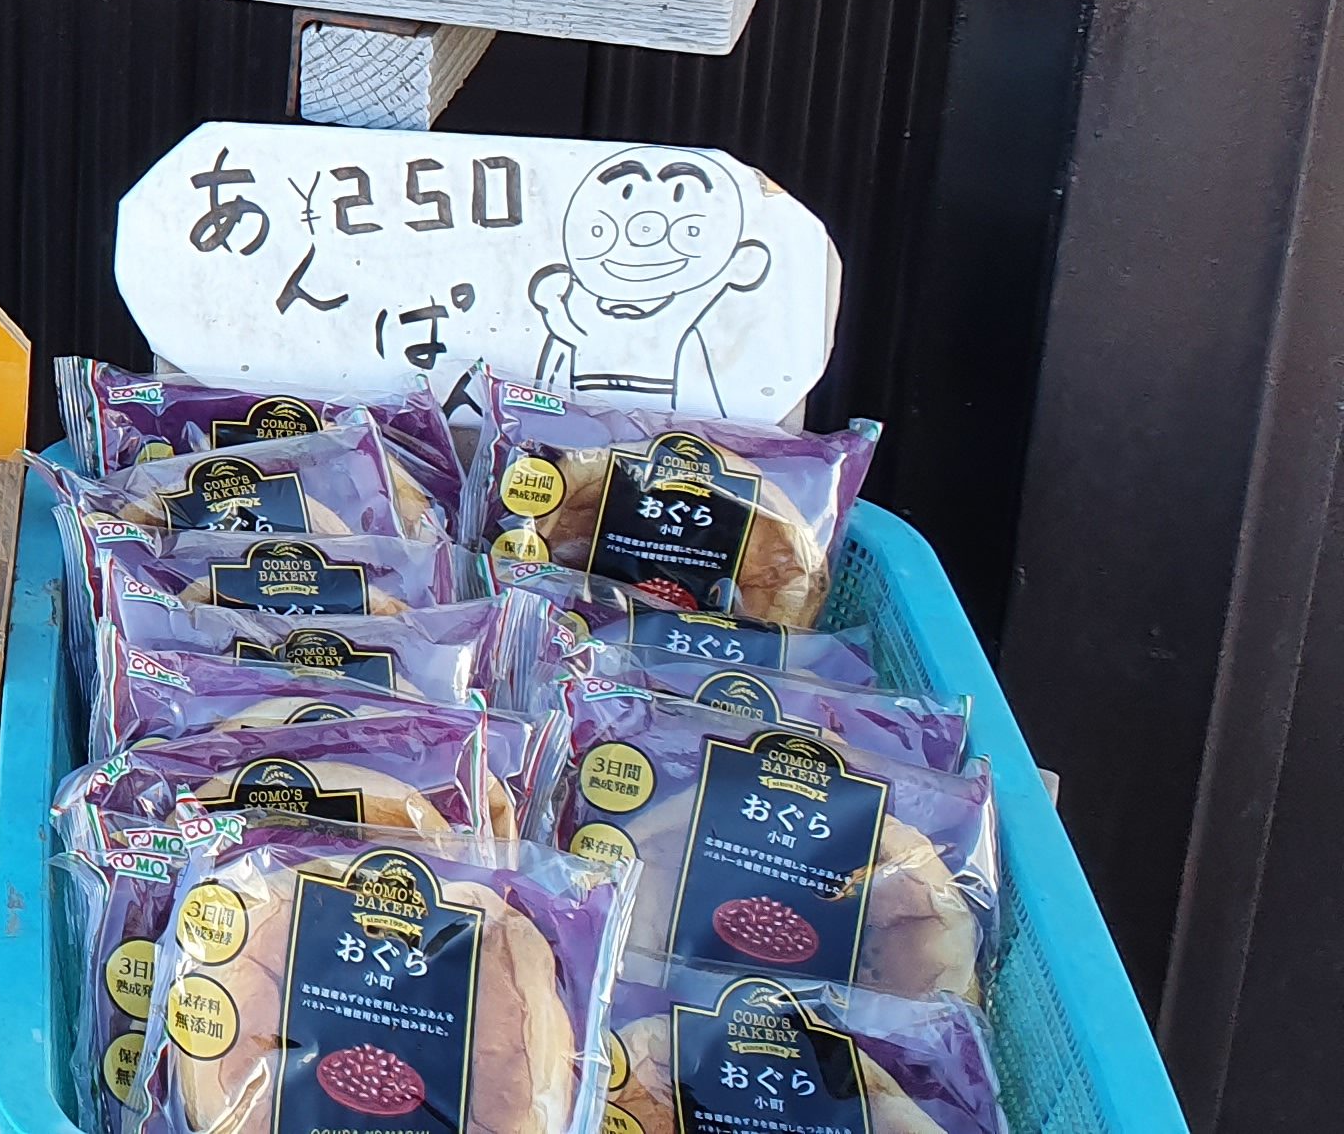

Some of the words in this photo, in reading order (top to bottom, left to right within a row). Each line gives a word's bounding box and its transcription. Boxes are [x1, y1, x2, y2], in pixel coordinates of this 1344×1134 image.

[287, 155, 524, 235] ¥250
[110, 387, 163, 402] COMO
[505, 386, 565, 412] COMO
[512, 472, 553, 491] 3日間
[638, 496, 713, 527] おぐら
[659, 525, 684, 538] 小町
[258, 569, 317, 583] BAKERY
[262, 559, 311, 572] COMO'S
[593, 757, 642, 782] 3日間
[760, 759, 831, 787] BAKERY
[768, 749, 827, 773] COMO'S
[249, 789, 303, 804] COMO'S
[741, 793, 831, 839] おぐら
[767, 830, 797, 849] 小町
[362, 880, 423, 904] COMO'S
[354, 894, 427, 920] BAKERY
[336, 933, 428, 977] おぐら
[364, 972, 395, 991] 小町
[178, 992, 221, 1016] 保存料
[174, 1010, 224, 1040] 無添加
[733, 1009, 791, 1029] COMO'S
[727, 1021, 800, 1043] BAKERY
[720, 1061, 816, 1097] おぐら
[754, 1096, 784, 1113] 小町
